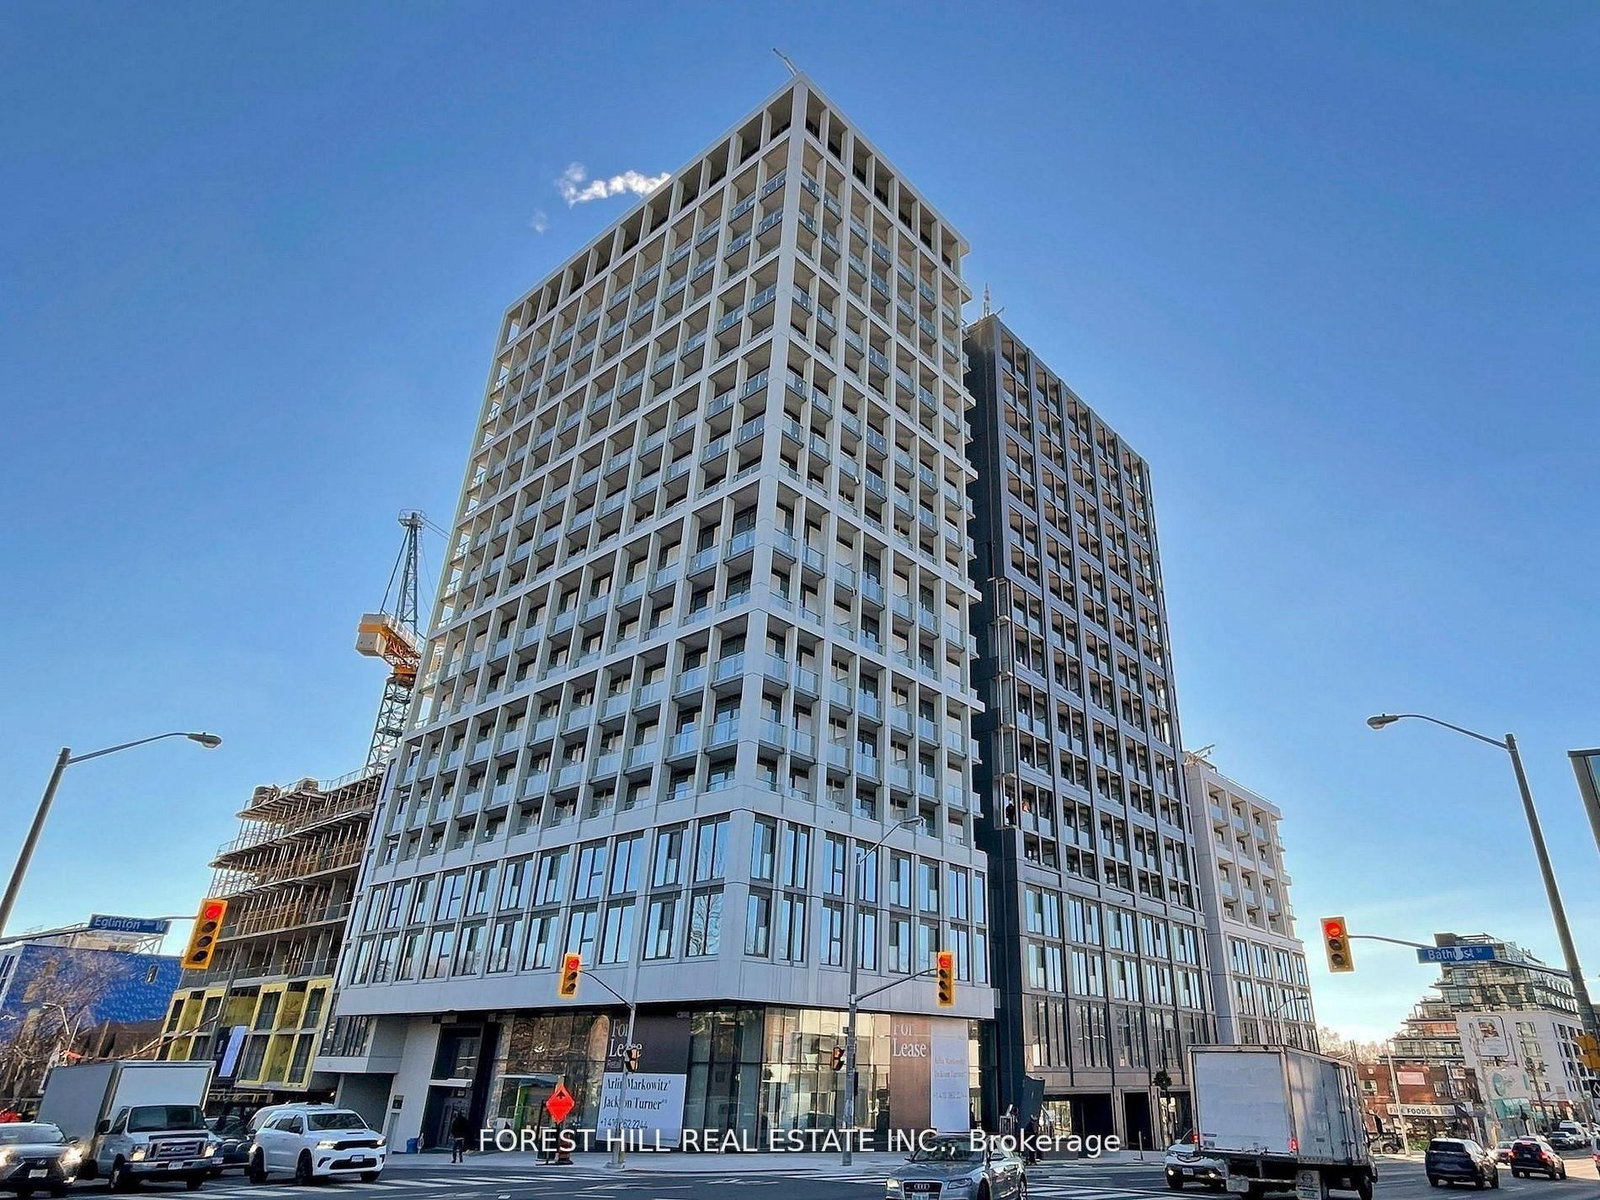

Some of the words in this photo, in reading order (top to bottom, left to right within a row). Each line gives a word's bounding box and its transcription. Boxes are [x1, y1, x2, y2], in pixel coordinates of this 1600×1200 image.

[94, 916, 140, 930] Eglinton
[155, 920, 166, 931] W
[1427, 947, 1475, 960] Bathust
[893, 1023, 913, 1036] For
[892, 1038, 927, 1057] Lease
